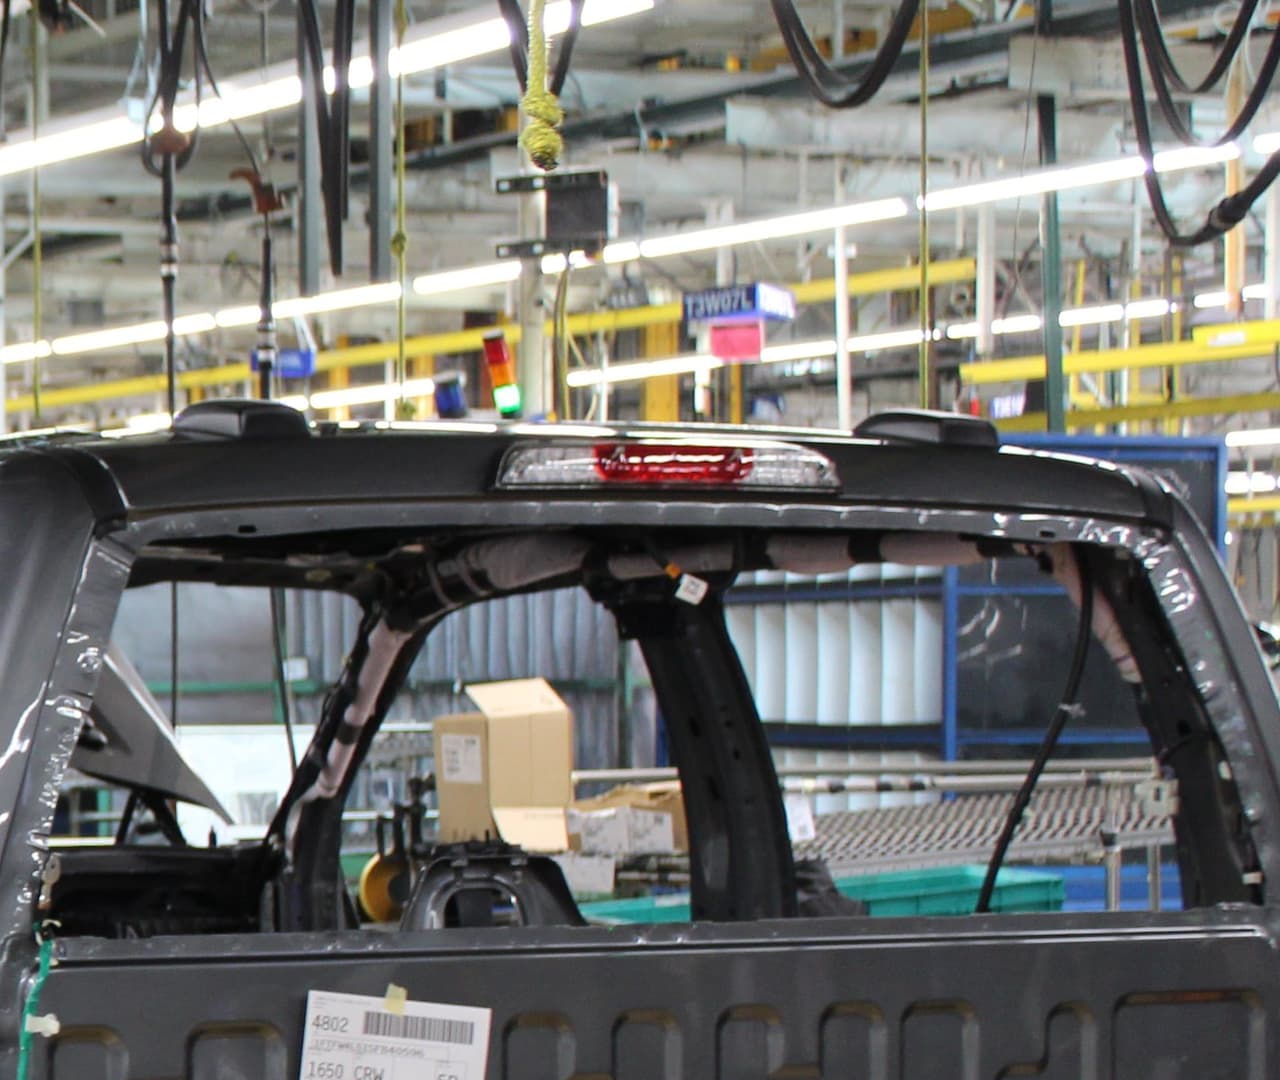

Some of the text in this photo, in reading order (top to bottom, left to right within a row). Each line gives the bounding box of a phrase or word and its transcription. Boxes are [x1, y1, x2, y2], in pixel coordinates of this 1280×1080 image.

[685, 288, 752, 318] T3W07L
[312, 1014, 348, 1033] 4802
[308, 1061, 344, 1079] 1650
